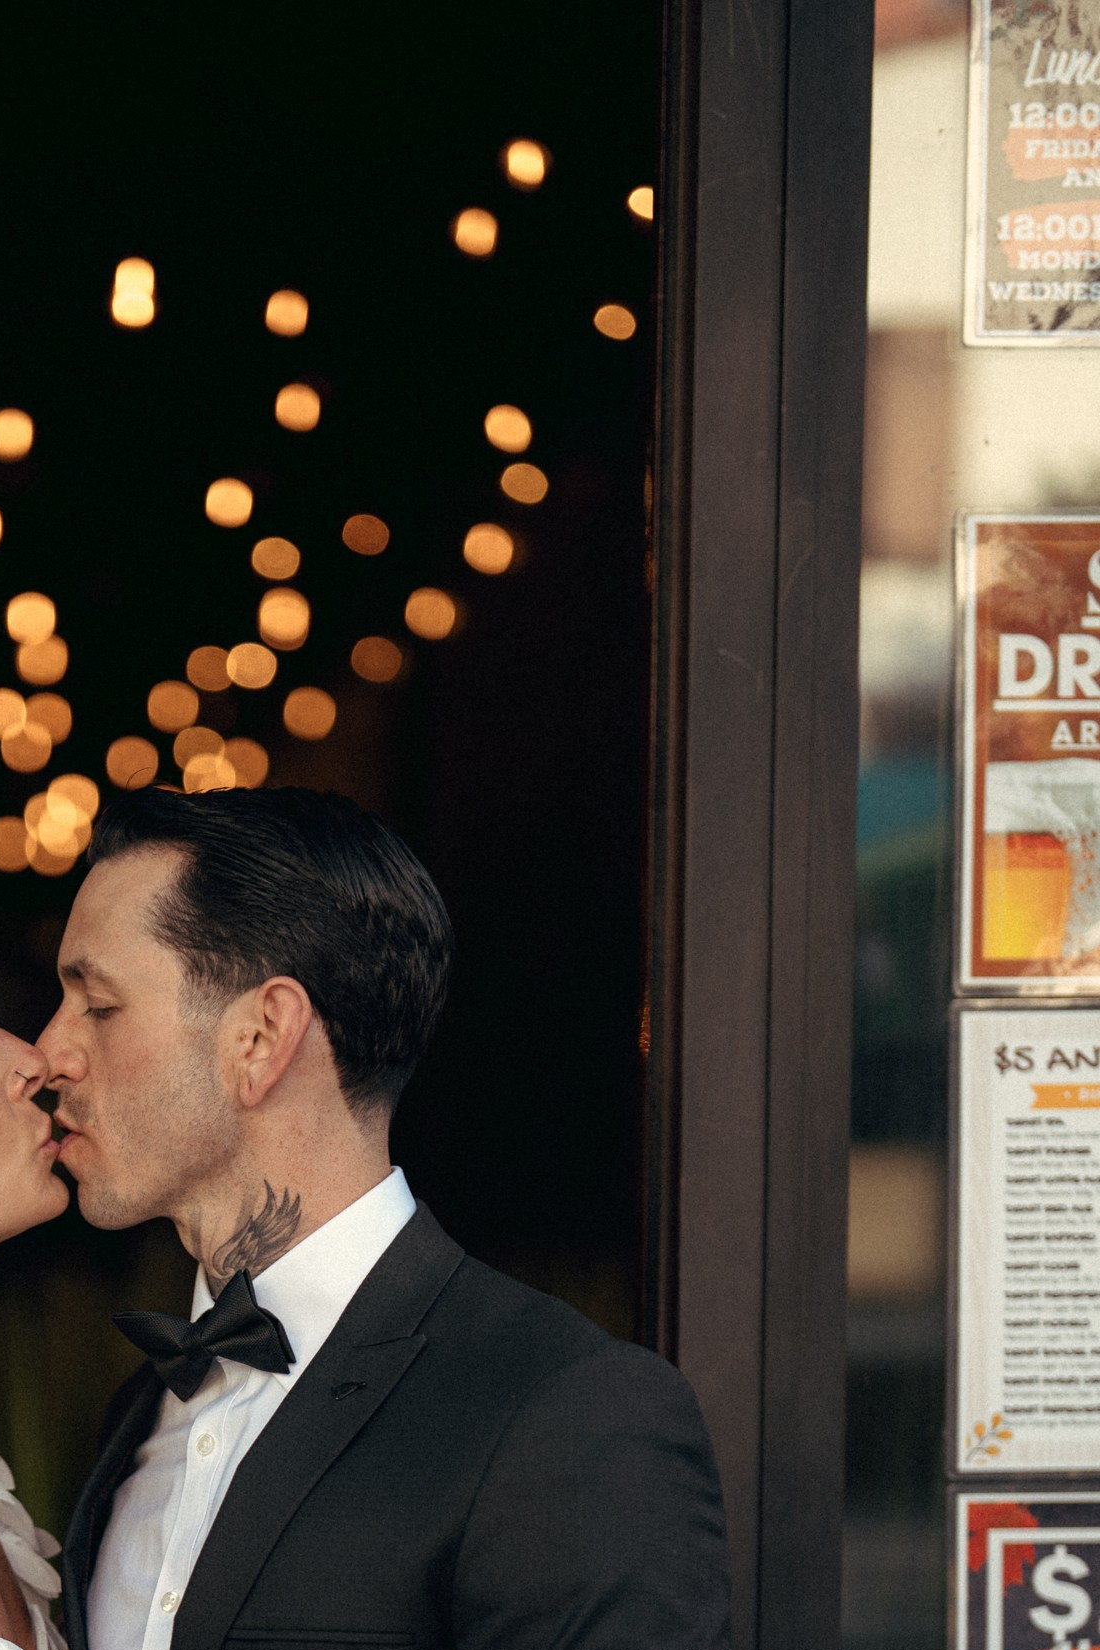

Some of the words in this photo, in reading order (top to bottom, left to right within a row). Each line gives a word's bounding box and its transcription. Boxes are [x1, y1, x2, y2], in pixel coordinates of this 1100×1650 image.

[1017, 249, 1100, 270] MOND
[998, 633, 1100, 698] DR
[995, 1042, 1035, 1076] $5
